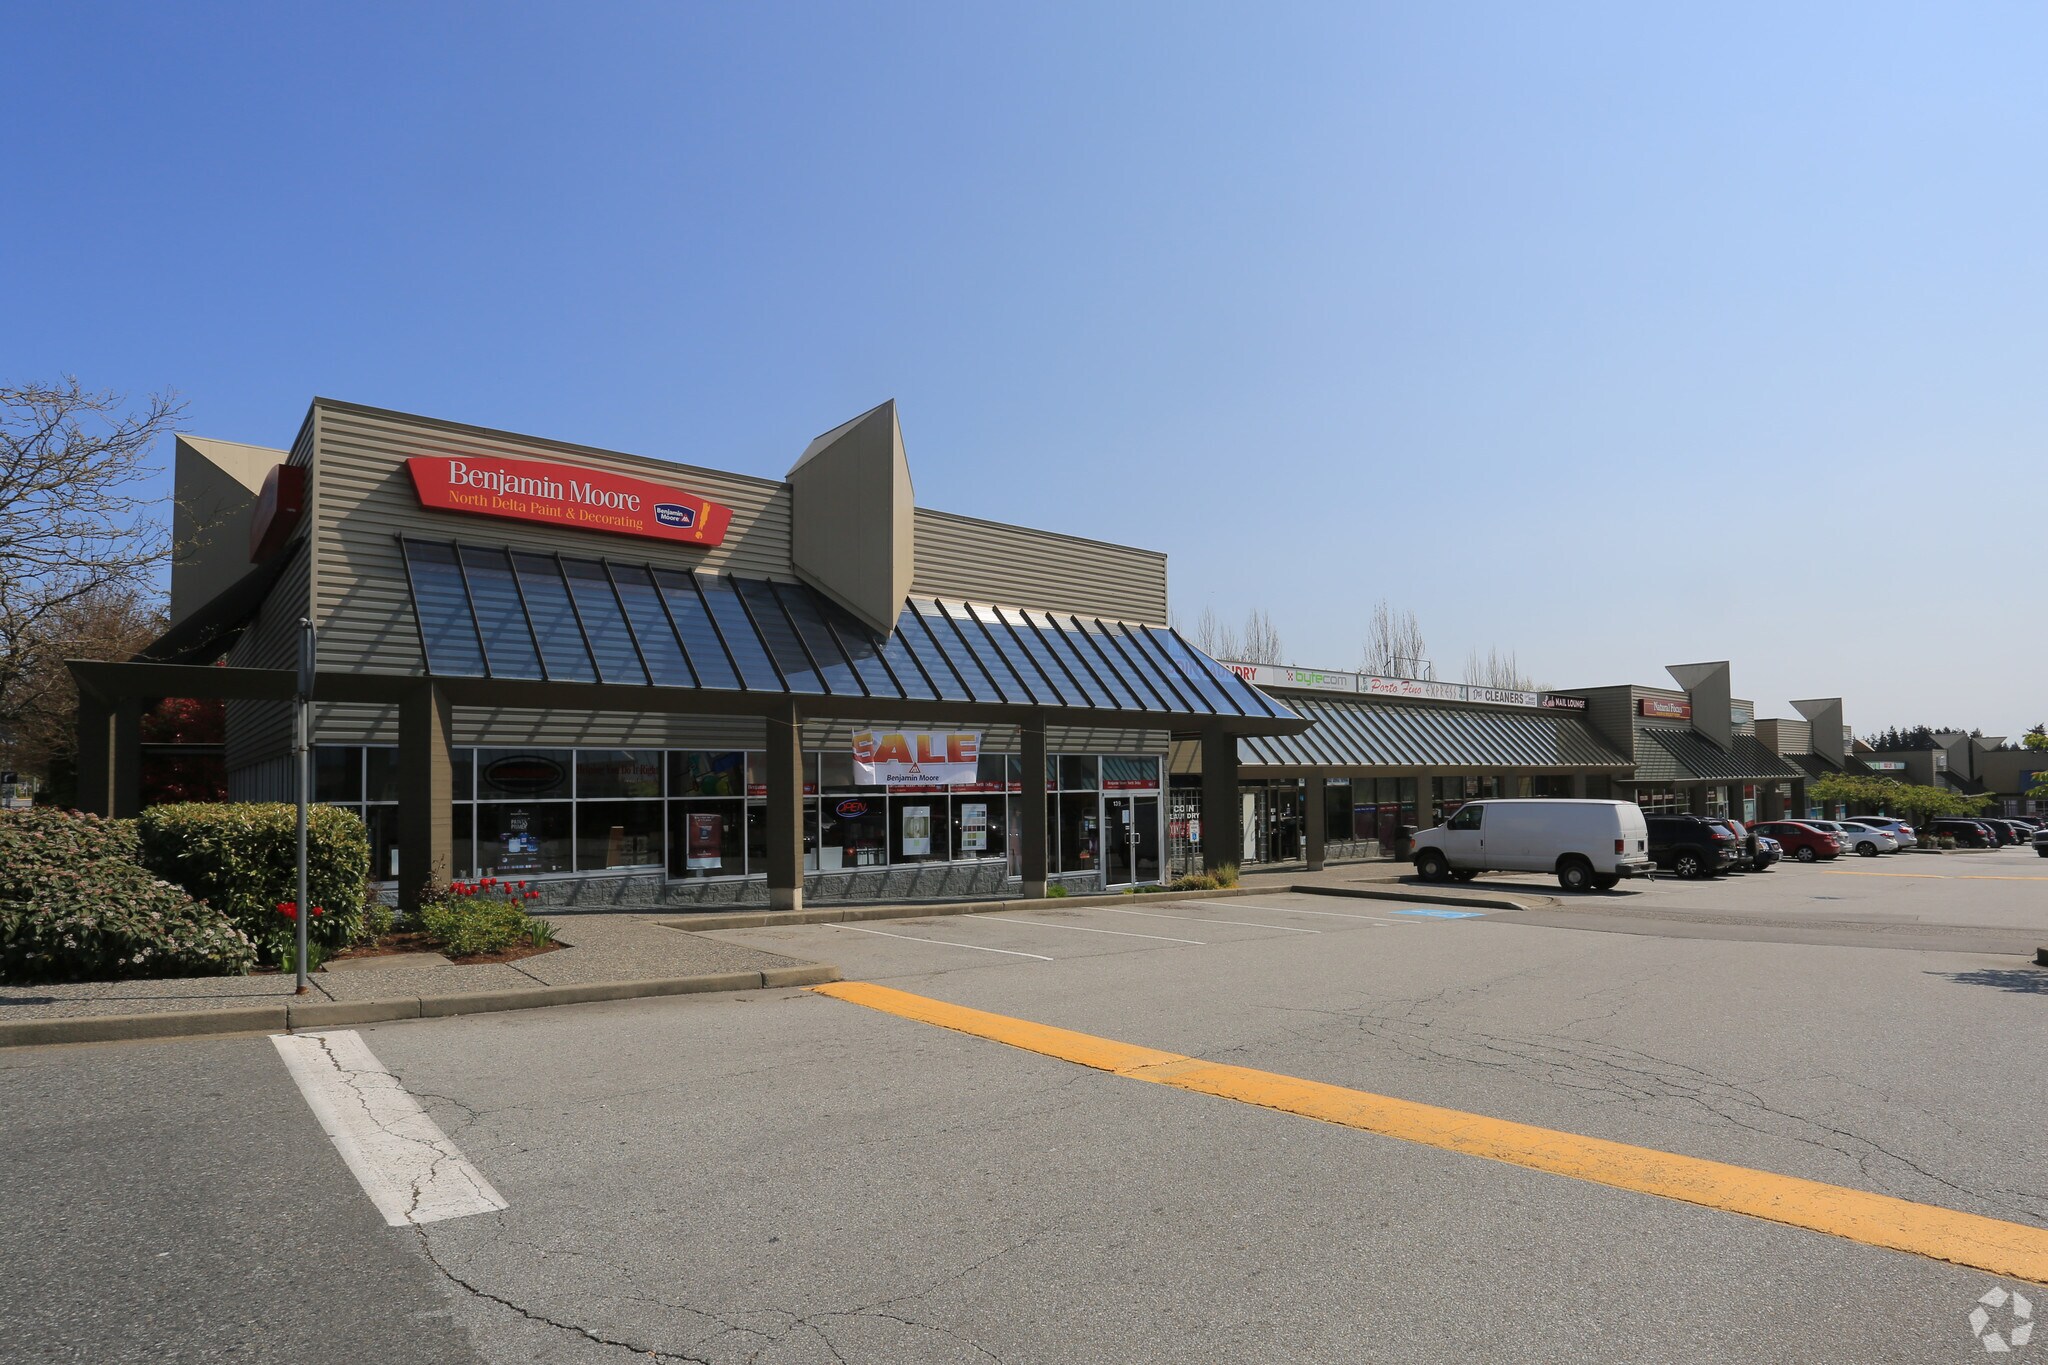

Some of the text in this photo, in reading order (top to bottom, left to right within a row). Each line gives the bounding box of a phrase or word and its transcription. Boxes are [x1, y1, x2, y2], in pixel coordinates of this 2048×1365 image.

[448, 460, 640, 512] Benjamin Moore
[449, 490, 643, 530] North Delta Paint & Decorating
[656, 507, 683, 517] Benjamin
[660, 513, 680, 522] Moore
[1295, 670, 1347, 686] bytecom
[1371, 678, 1398, 693] Porto
[1401, 680, 1422, 695] Fino
[1485, 690, 1524, 704] CLEANERS
[1555, 698, 1567, 706] NAIL
[852, 732, 977, 764] SALE
[886, 774, 918, 782] Benjamin
[839, 802, 867, 812] OPEN
[1173, 805, 1195, 813] COIN
